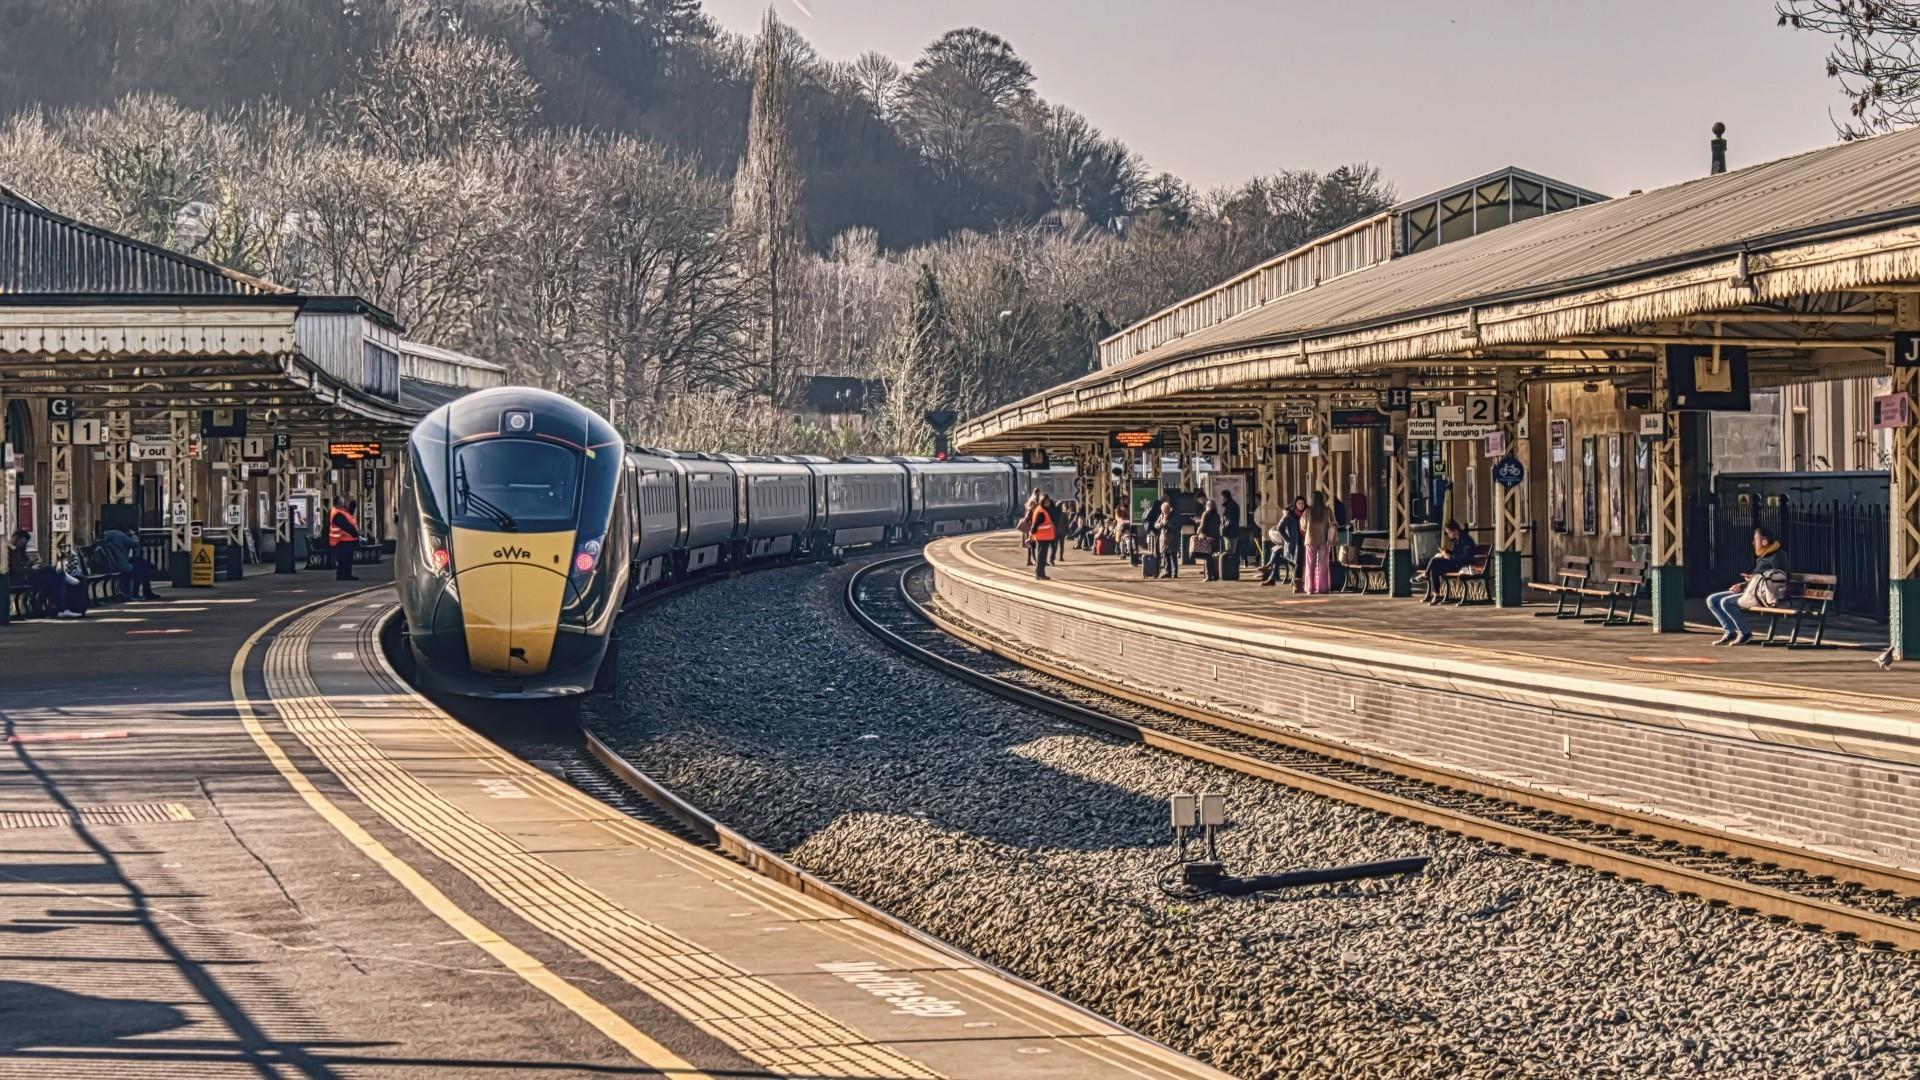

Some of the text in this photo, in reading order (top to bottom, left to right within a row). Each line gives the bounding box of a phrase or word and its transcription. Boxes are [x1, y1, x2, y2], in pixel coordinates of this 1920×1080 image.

[1904, 337, 1920, 361] J
[1392, 390, 1408, 405] H
[52, 400, 68, 416] G
[1473, 400, 1488, 420] 2
[1218, 418, 1230, 430] G
[83, 422, 91, 441] 1
[1443, 429, 1480, 437] changing
[250, 440, 257, 454] 1
[278, 435, 287, 446] E
[1202, 435, 1213, 449] 2
[149, 447, 166, 456] out
[54, 512, 68, 521] Lift
[493, 545, 531, 560] GWR
